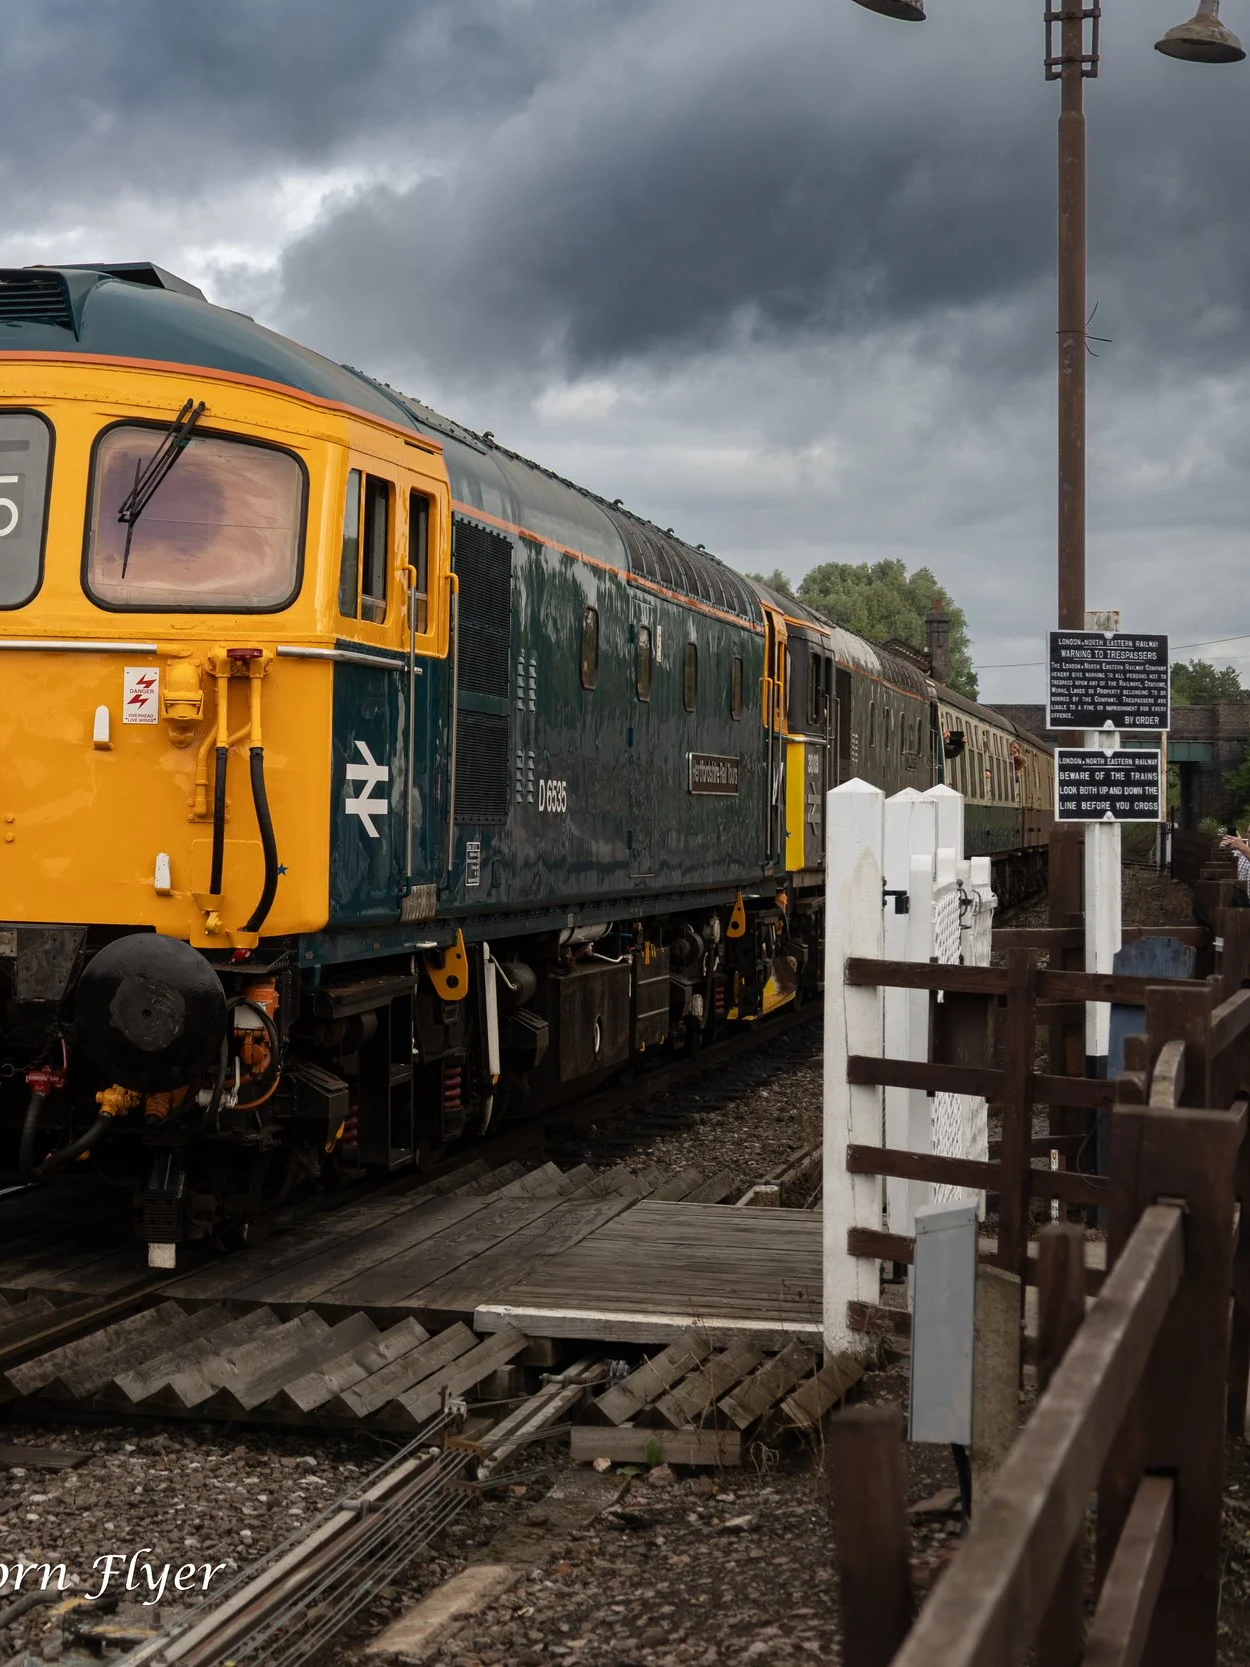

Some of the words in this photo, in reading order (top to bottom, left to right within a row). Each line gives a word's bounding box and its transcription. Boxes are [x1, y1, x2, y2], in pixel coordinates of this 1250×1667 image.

[1061, 649, 1092, 658] WARNING
[1094, 650, 1104, 658] TO
[1107, 650, 1157, 660] TRESPASSERS
[1122, 696, 1154, 704] TRESPASSERS
[1124, 716, 1134, 724] BY
[1136, 716, 1159, 724] ORDER
[1059, 772, 1090, 780] BEWARE
[1094, 772, 1105, 780] OF
[1110, 772, 1125, 780] THE
[1130, 772, 1158, 780] TRAINS
[1059, 786, 1077, 794] LOOK
[1079, 786, 1097, 794] BOTH
[1099, 786, 1109, 794] UP
[1110, 786, 1122, 795] AND
[1124, 787, 1143, 795] DOWN
[1145, 787, 1158, 795] THE
[1059, 802, 1077, 810] LINE
[1081, 802, 1111, 810] BEFORE
[1116, 802, 1130, 810] YOU
[1134, 802, 1158, 810] CROSS
